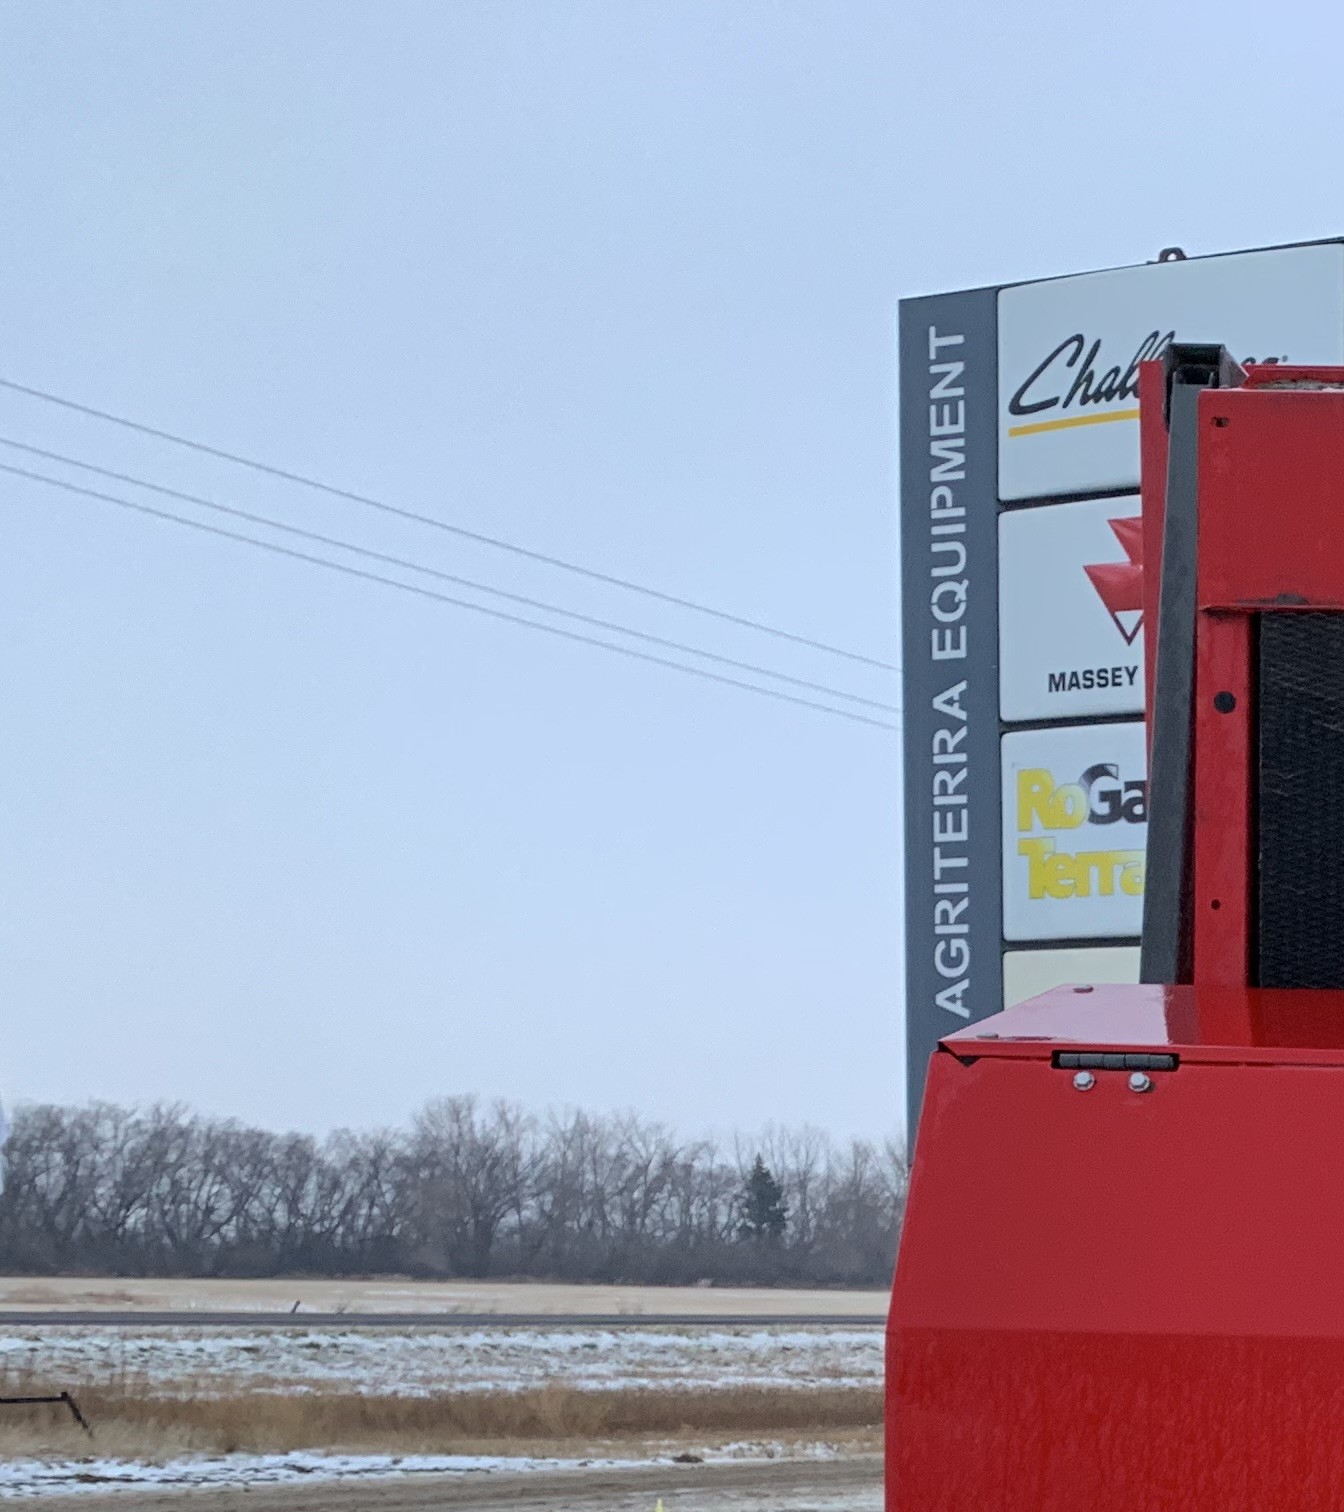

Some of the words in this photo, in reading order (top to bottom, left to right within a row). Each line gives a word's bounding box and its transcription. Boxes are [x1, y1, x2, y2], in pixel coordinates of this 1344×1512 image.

[1008, 330, 1279, 416] Chall
[929, 325, 969, 661] EQUIPMENT
[1048, 666, 1139, 693] MASSEY
[932, 680, 970, 1019] AGRITERRA
